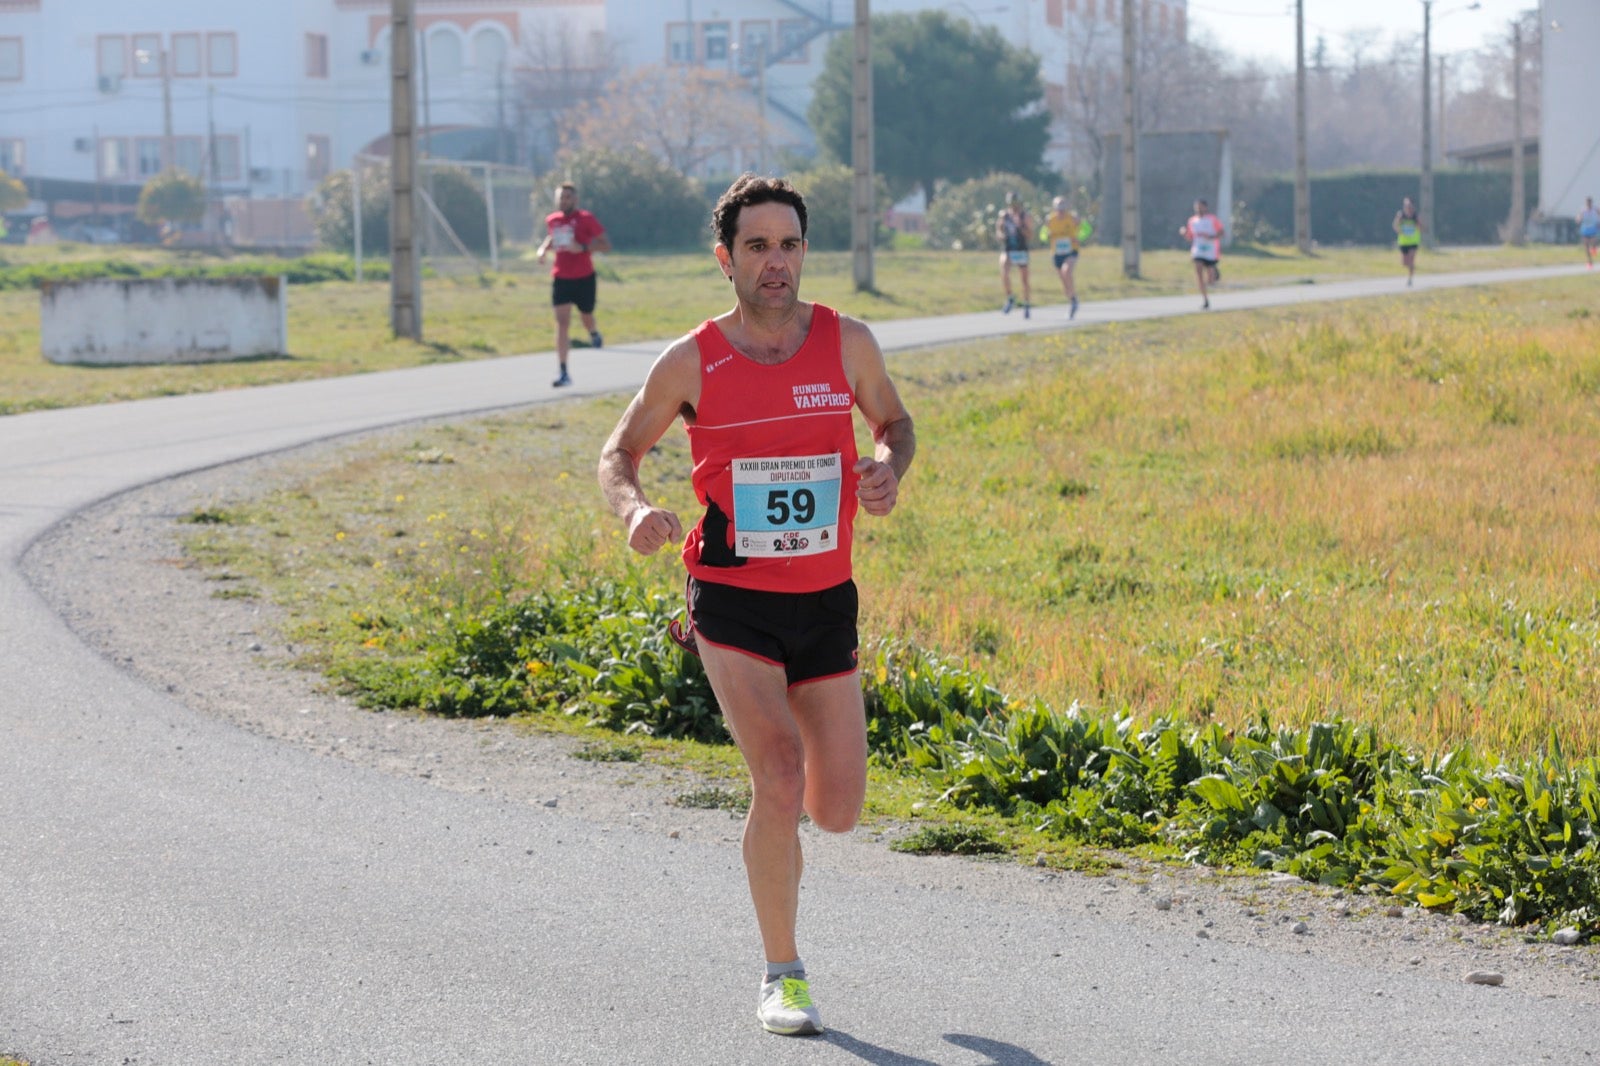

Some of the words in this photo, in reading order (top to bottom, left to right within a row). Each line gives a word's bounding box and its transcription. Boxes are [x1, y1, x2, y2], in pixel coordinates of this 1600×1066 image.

[793, 383, 831, 395] RUNNING
[793, 393, 850, 409] VAMPIROS
[739, 461, 759, 471] XXXIII
[760, 461, 779, 471] GRAN
[781, 460, 806, 470] PREMIO
[807, 459, 816, 469] DE
[816, 457, 836, 468] FONDO
[770, 471, 811, 482] DIPUTACIÓN
[766, 488, 816, 525] 59
